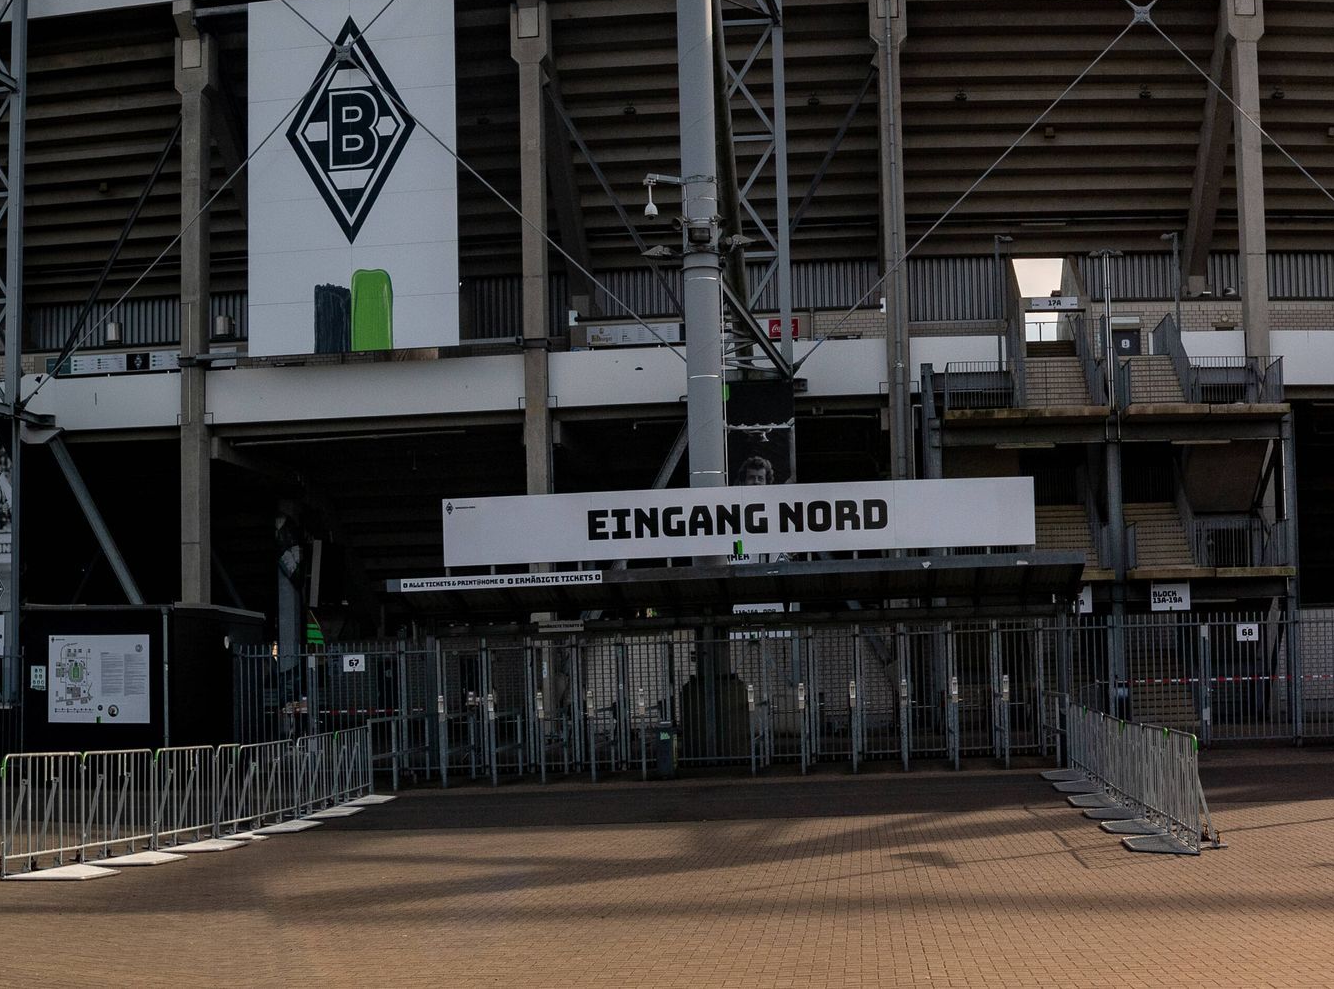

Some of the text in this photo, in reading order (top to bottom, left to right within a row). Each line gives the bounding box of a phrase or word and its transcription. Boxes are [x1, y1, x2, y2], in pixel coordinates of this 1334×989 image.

[587, 499, 888, 540] EINGANG NORD
[561, 574, 593, 582] TICKETS
[1242, 628, 1253, 636] 68
[349, 659, 359, 667] 67
